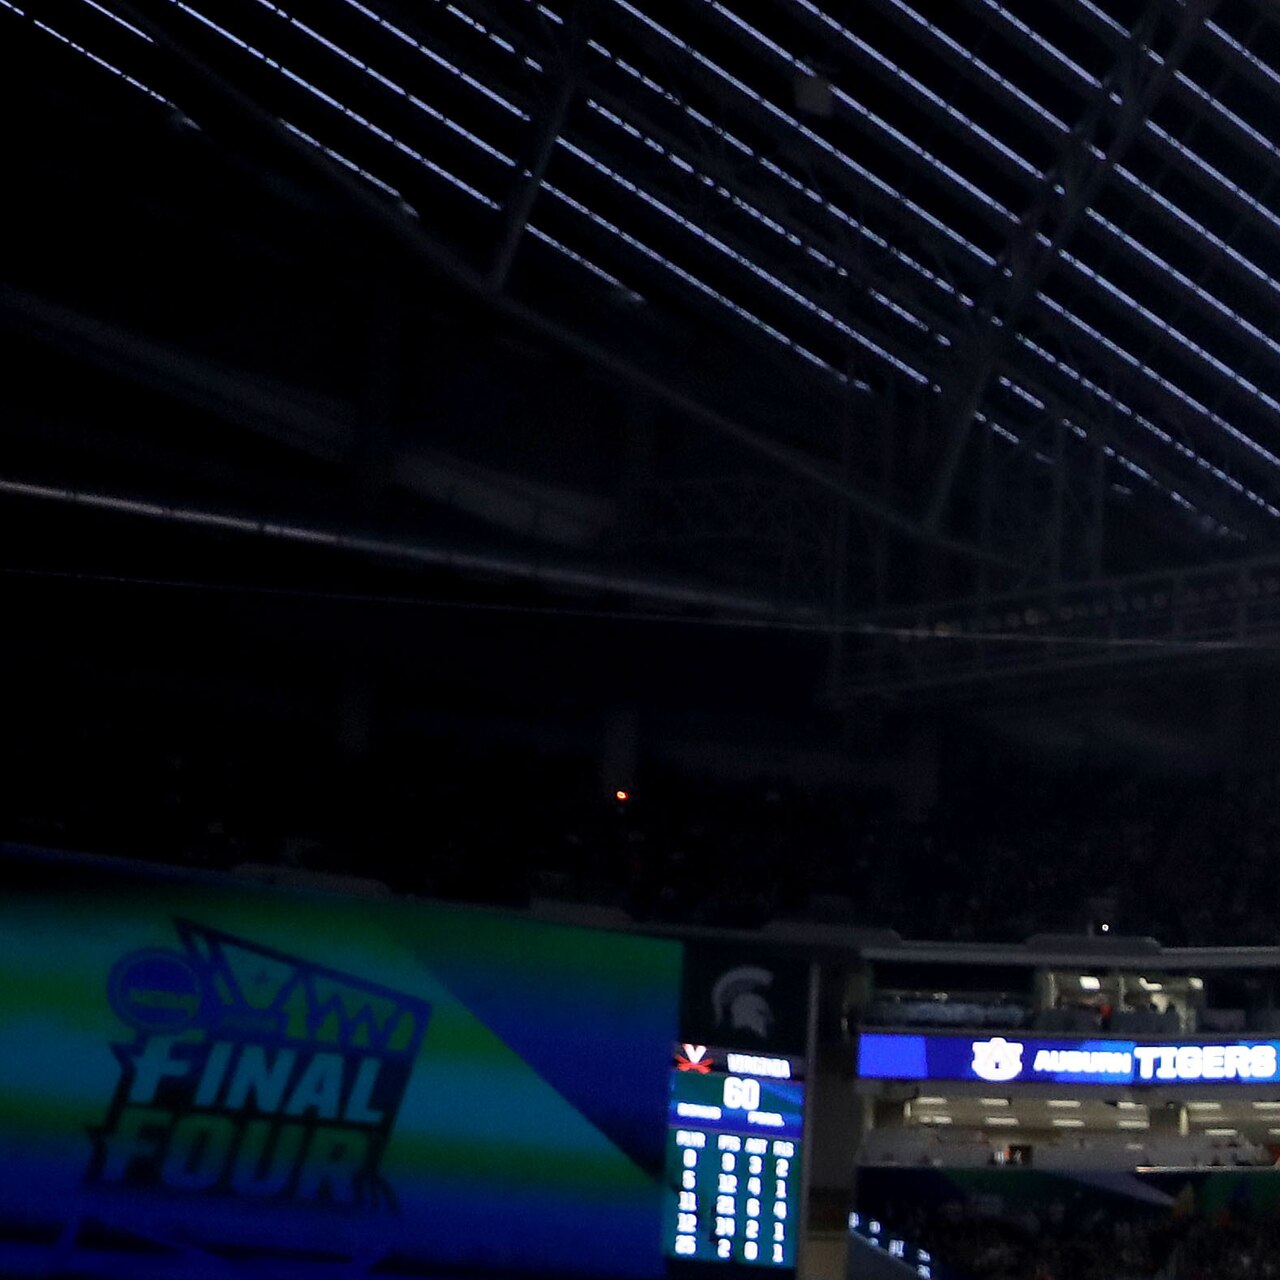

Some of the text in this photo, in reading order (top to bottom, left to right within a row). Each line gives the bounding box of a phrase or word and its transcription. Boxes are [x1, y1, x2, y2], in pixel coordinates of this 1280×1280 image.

[1033, 1049, 1132, 1074] AUBURN
[1133, 1045, 1278, 1079] TIGERS
[125, 1034, 385, 1124] FINAL
[723, 1076, 761, 1111] 60
[105, 1107, 368, 1201] FOUR
[776, 1158, 789, 1177] 2
[719, 1173, 738, 1193] 12
[776, 1179, 787, 1198] 1
[679, 1191, 697, 1211] 11
[677, 1212, 697, 1232] 12
[746, 1219, 759, 1239] 2
[774, 1222, 785, 1241] 1
[717, 1238, 731, 1258] 2
[772, 1243, 784, 1262] 1
